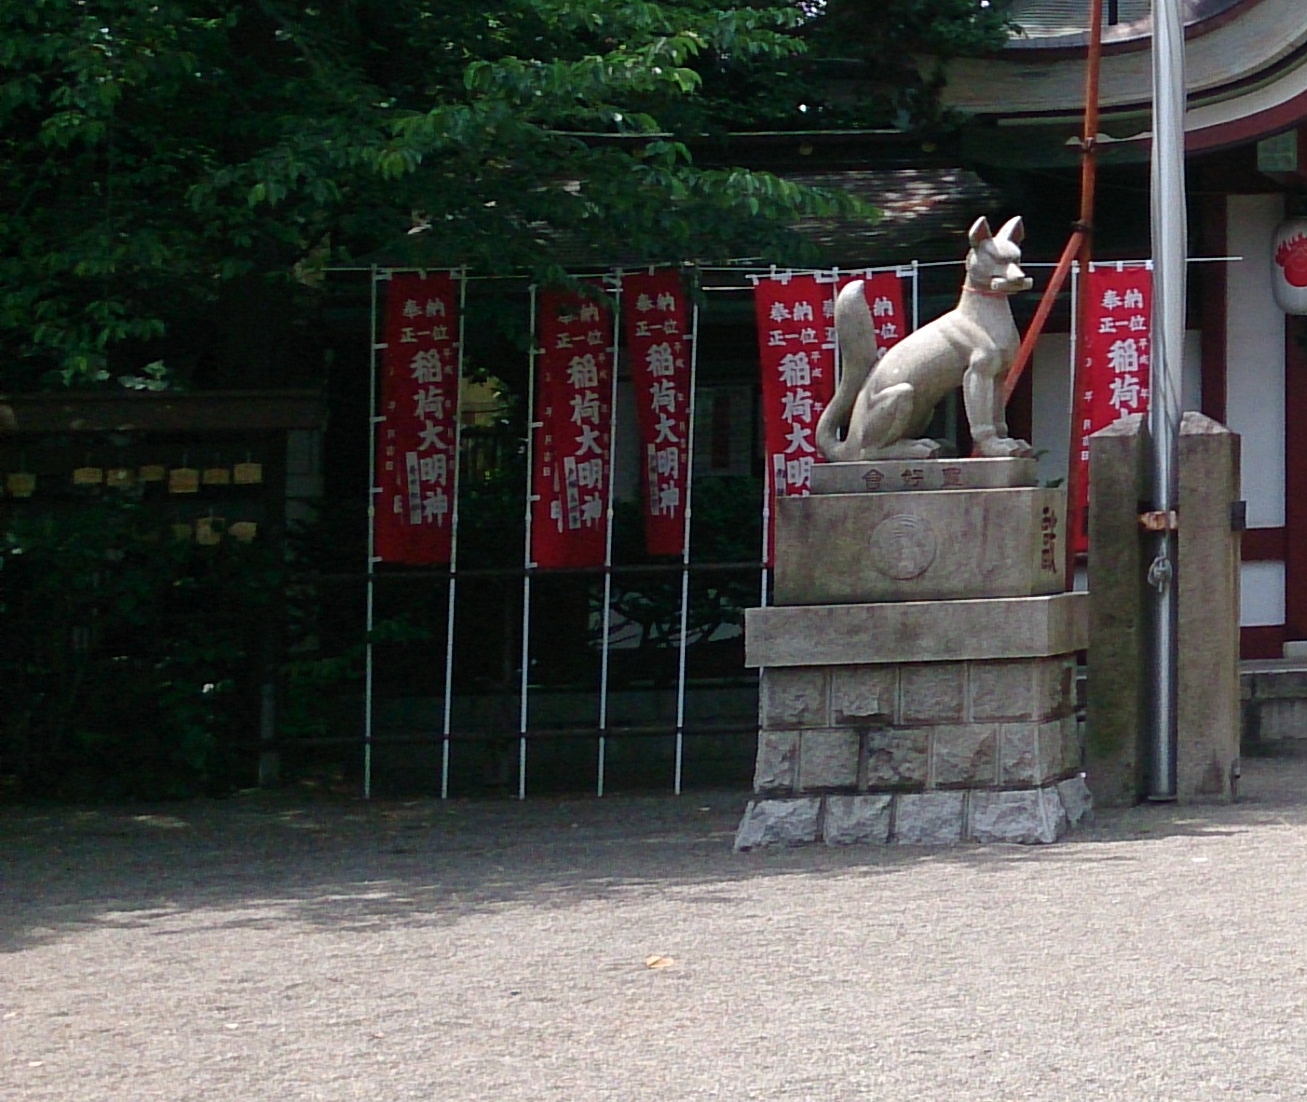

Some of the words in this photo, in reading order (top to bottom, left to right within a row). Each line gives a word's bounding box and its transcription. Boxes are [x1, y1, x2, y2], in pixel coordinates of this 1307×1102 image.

[403, 298, 446, 318] 奉納
[636, 292, 676, 313] 奉納
[1101, 289, 1144, 310] 奉納
[769, 301, 814, 322] 奉納
[400, 324, 449, 343] 正一位
[635, 319, 679, 337] 正一位
[1098, 316, 1147, 334] 正一位
[556, 332, 604, 350] 正一位
[767, 328, 818, 347] 正一位
[646, 341, 680, 520] 稲荷大明神
[778, 350, 815, 497] 稲荷大明
[409, 348, 449, 528] 稲荷大明神
[566, 353, 603, 528] 稲荷大明神
